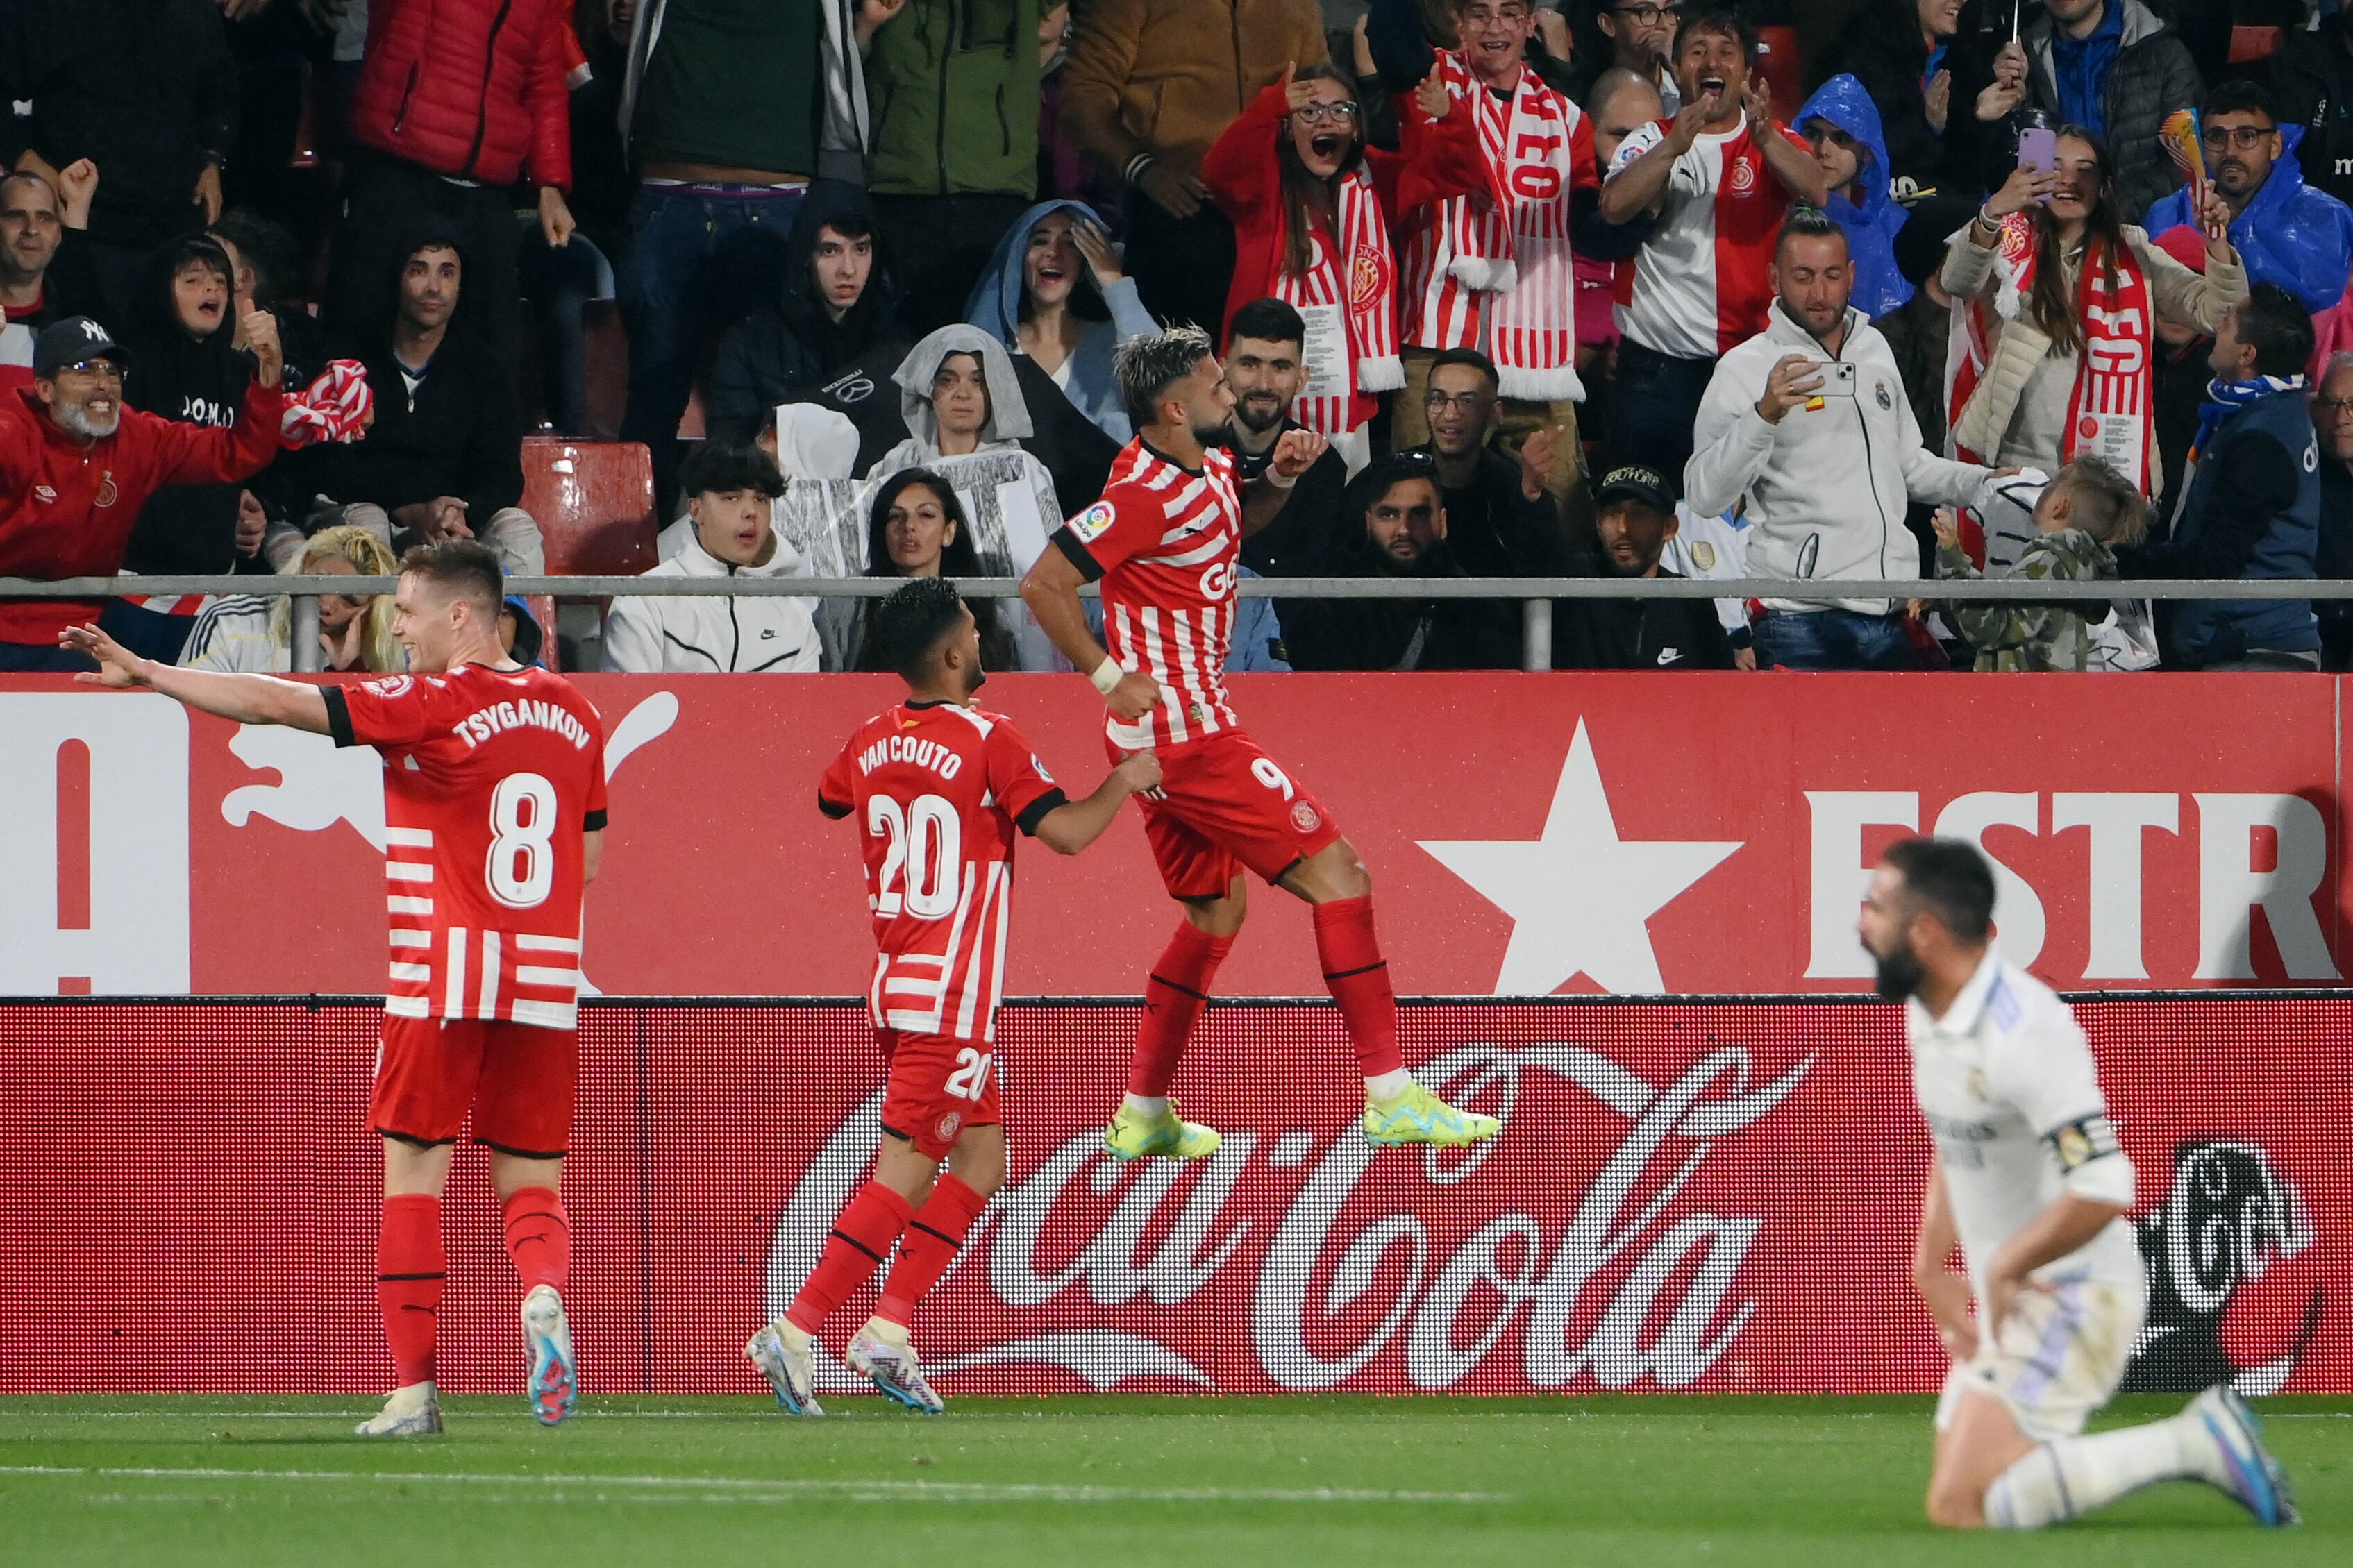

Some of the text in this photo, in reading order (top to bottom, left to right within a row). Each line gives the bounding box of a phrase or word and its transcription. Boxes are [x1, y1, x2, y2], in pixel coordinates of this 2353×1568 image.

[453, 698, 590, 750] TSYGANKOV
[857, 735, 962, 780] YAN COUTO
[1250, 757, 1294, 801] 9
[485, 772, 558, 909] 8
[868, 793, 962, 920] 20
[943, 1047, 993, 1102] 20
[766, 1041, 1819, 1388] Cca-Cola
